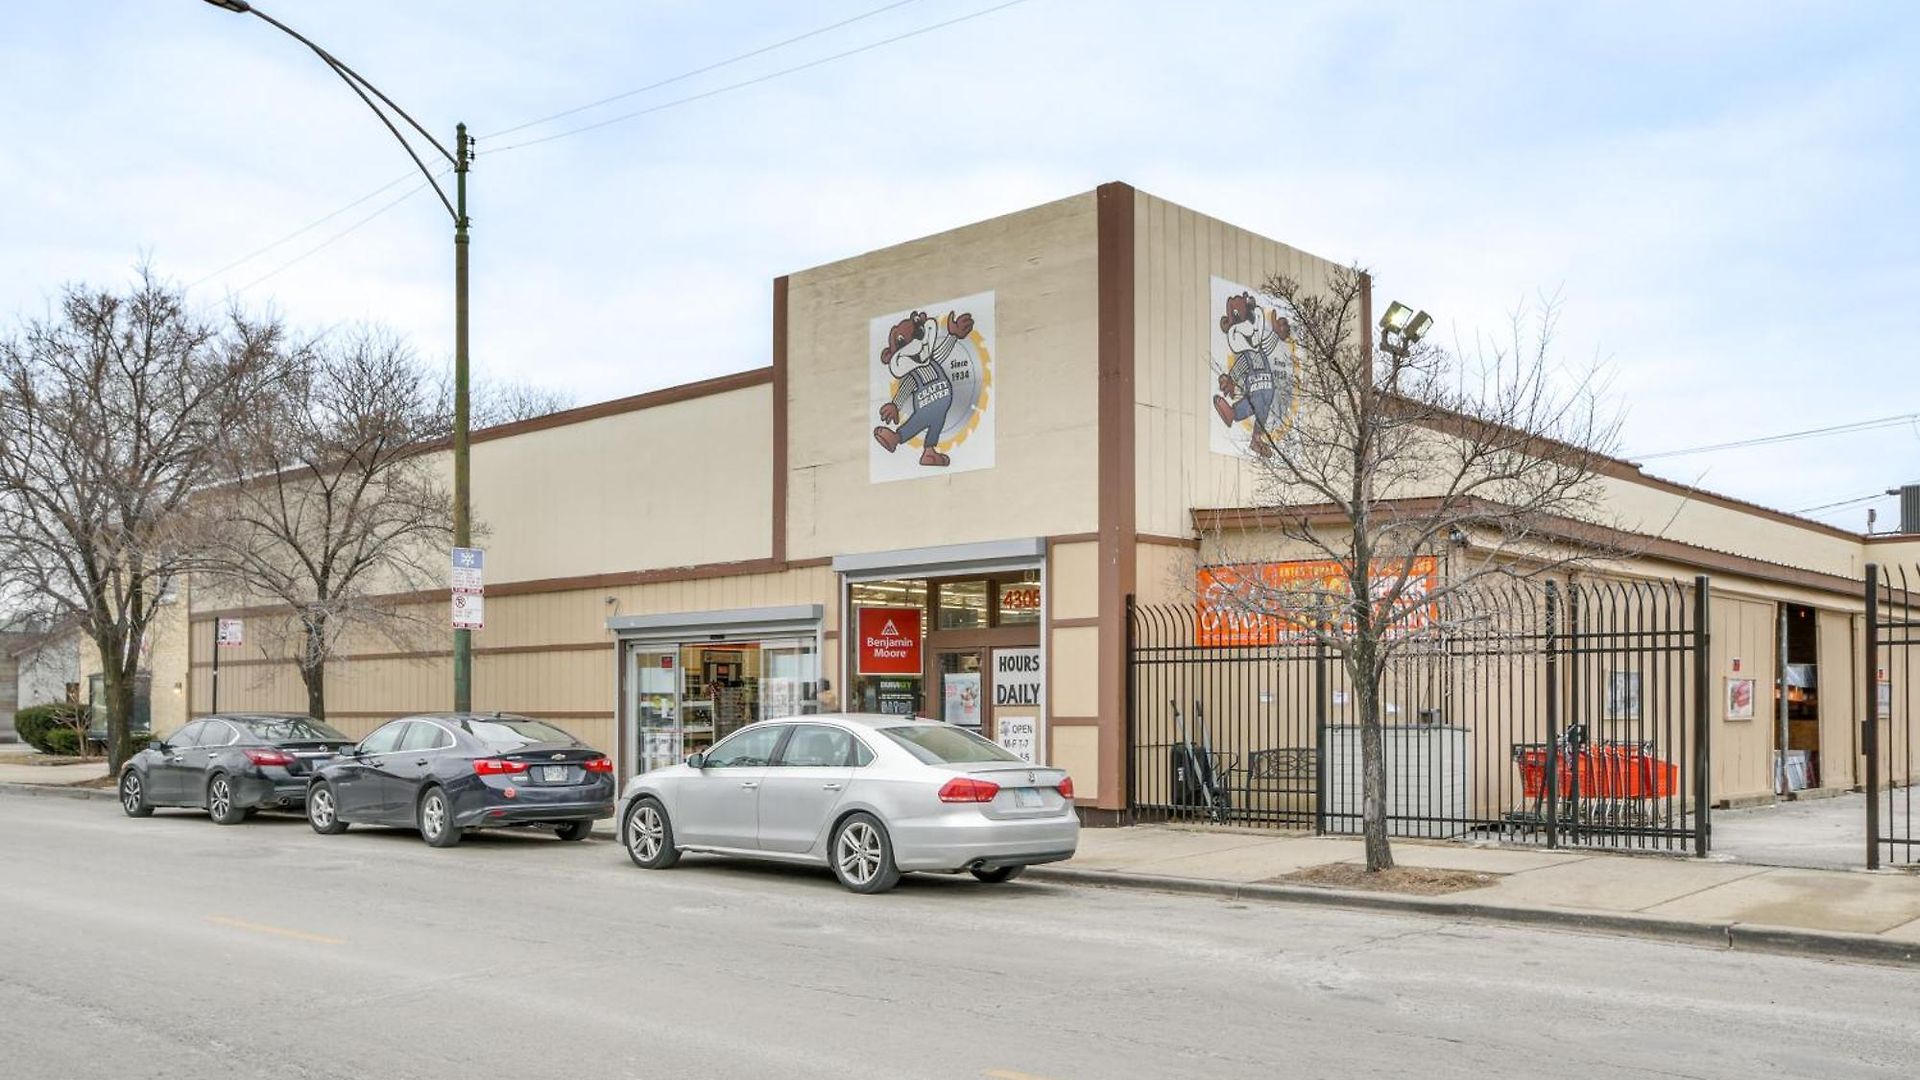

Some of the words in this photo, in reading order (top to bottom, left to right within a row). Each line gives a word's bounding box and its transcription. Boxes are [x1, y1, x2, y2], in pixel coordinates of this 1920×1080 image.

[951, 359, 968, 369] Since
[951, 370, 970, 381] 1934
[867, 637, 914, 650] Benjamin
[874, 648, 907, 658] Moore
[999, 655, 1040, 672] HOURS
[997, 683, 1041, 705] DAILY
[1012, 724, 1034, 735] OPEN
